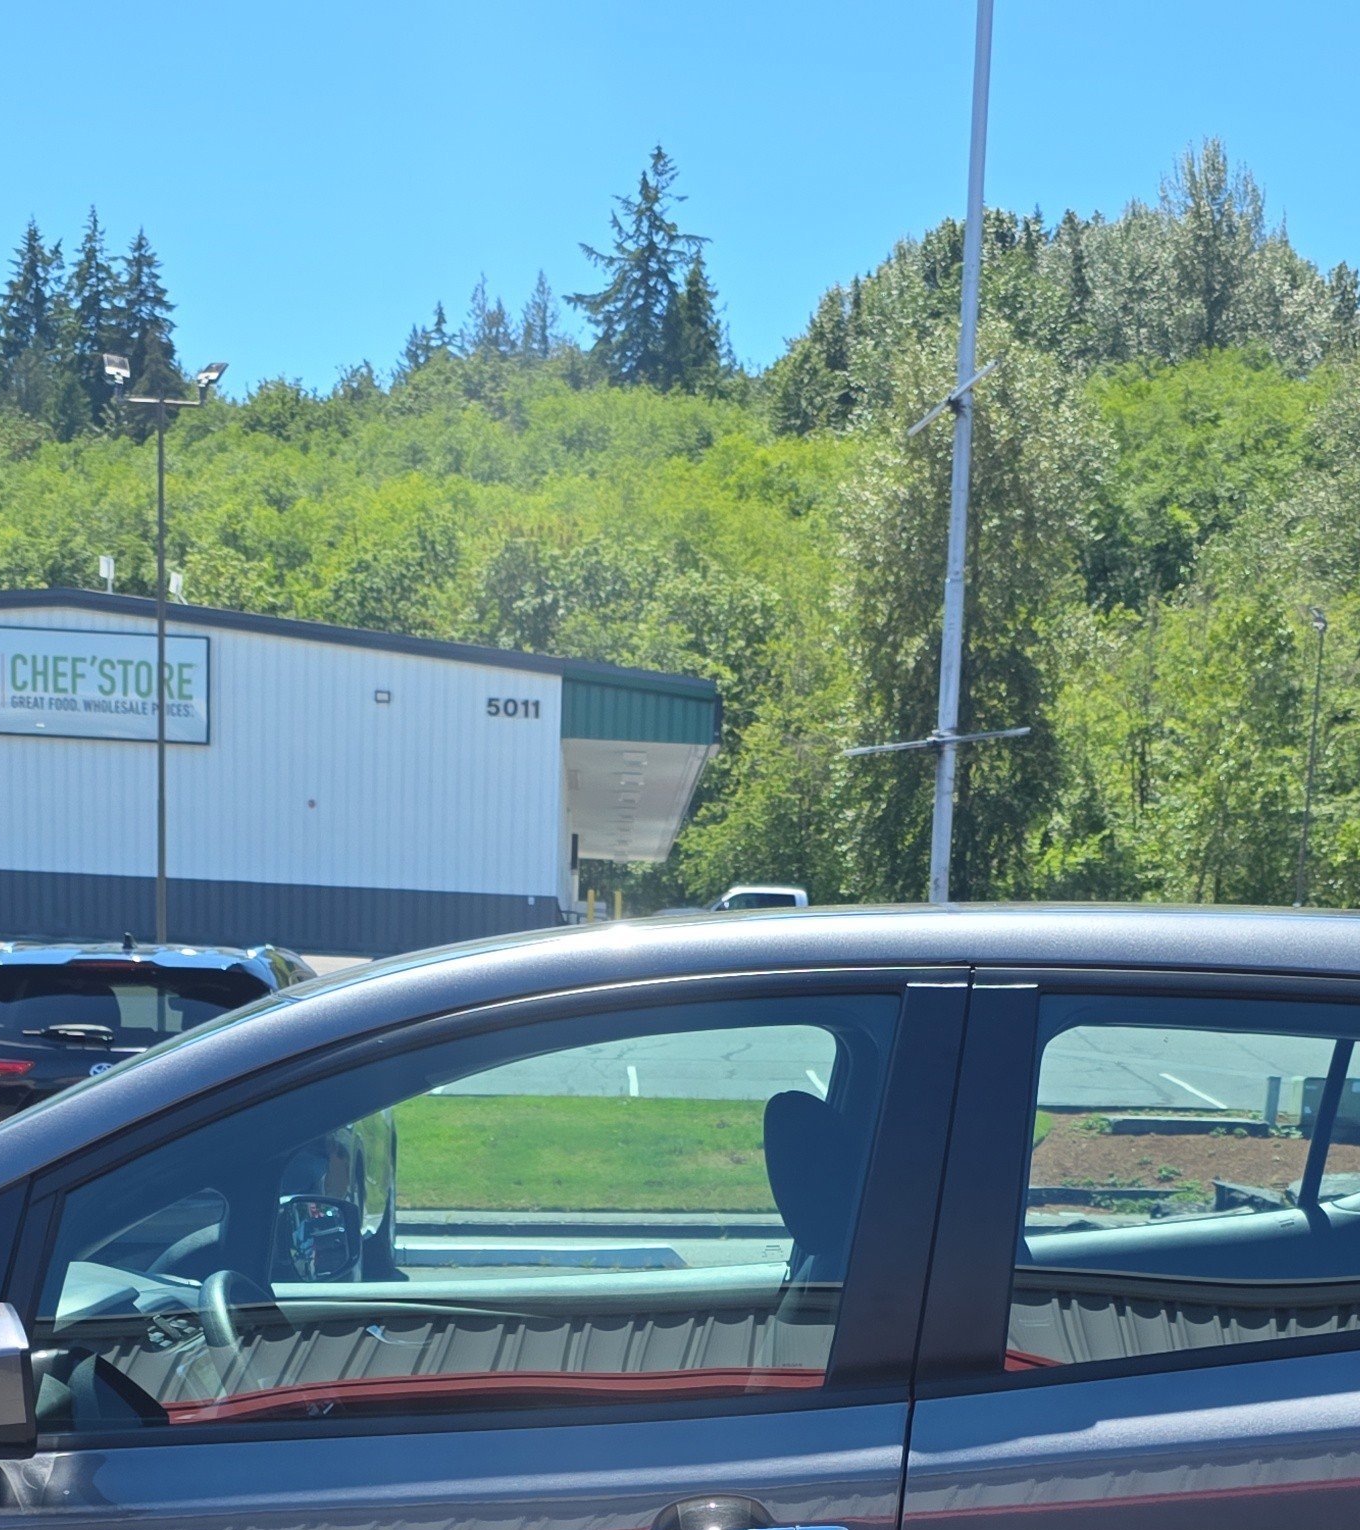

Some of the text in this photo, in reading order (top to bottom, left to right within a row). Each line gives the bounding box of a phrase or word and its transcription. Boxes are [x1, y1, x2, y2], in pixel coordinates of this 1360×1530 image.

[10, 653, 196, 701] CHEF'STORE
[10, 694, 46, 711] GREAT
[82, 702, 148, 717] WHOLESALE
[487, 697, 540, 719] 5011
